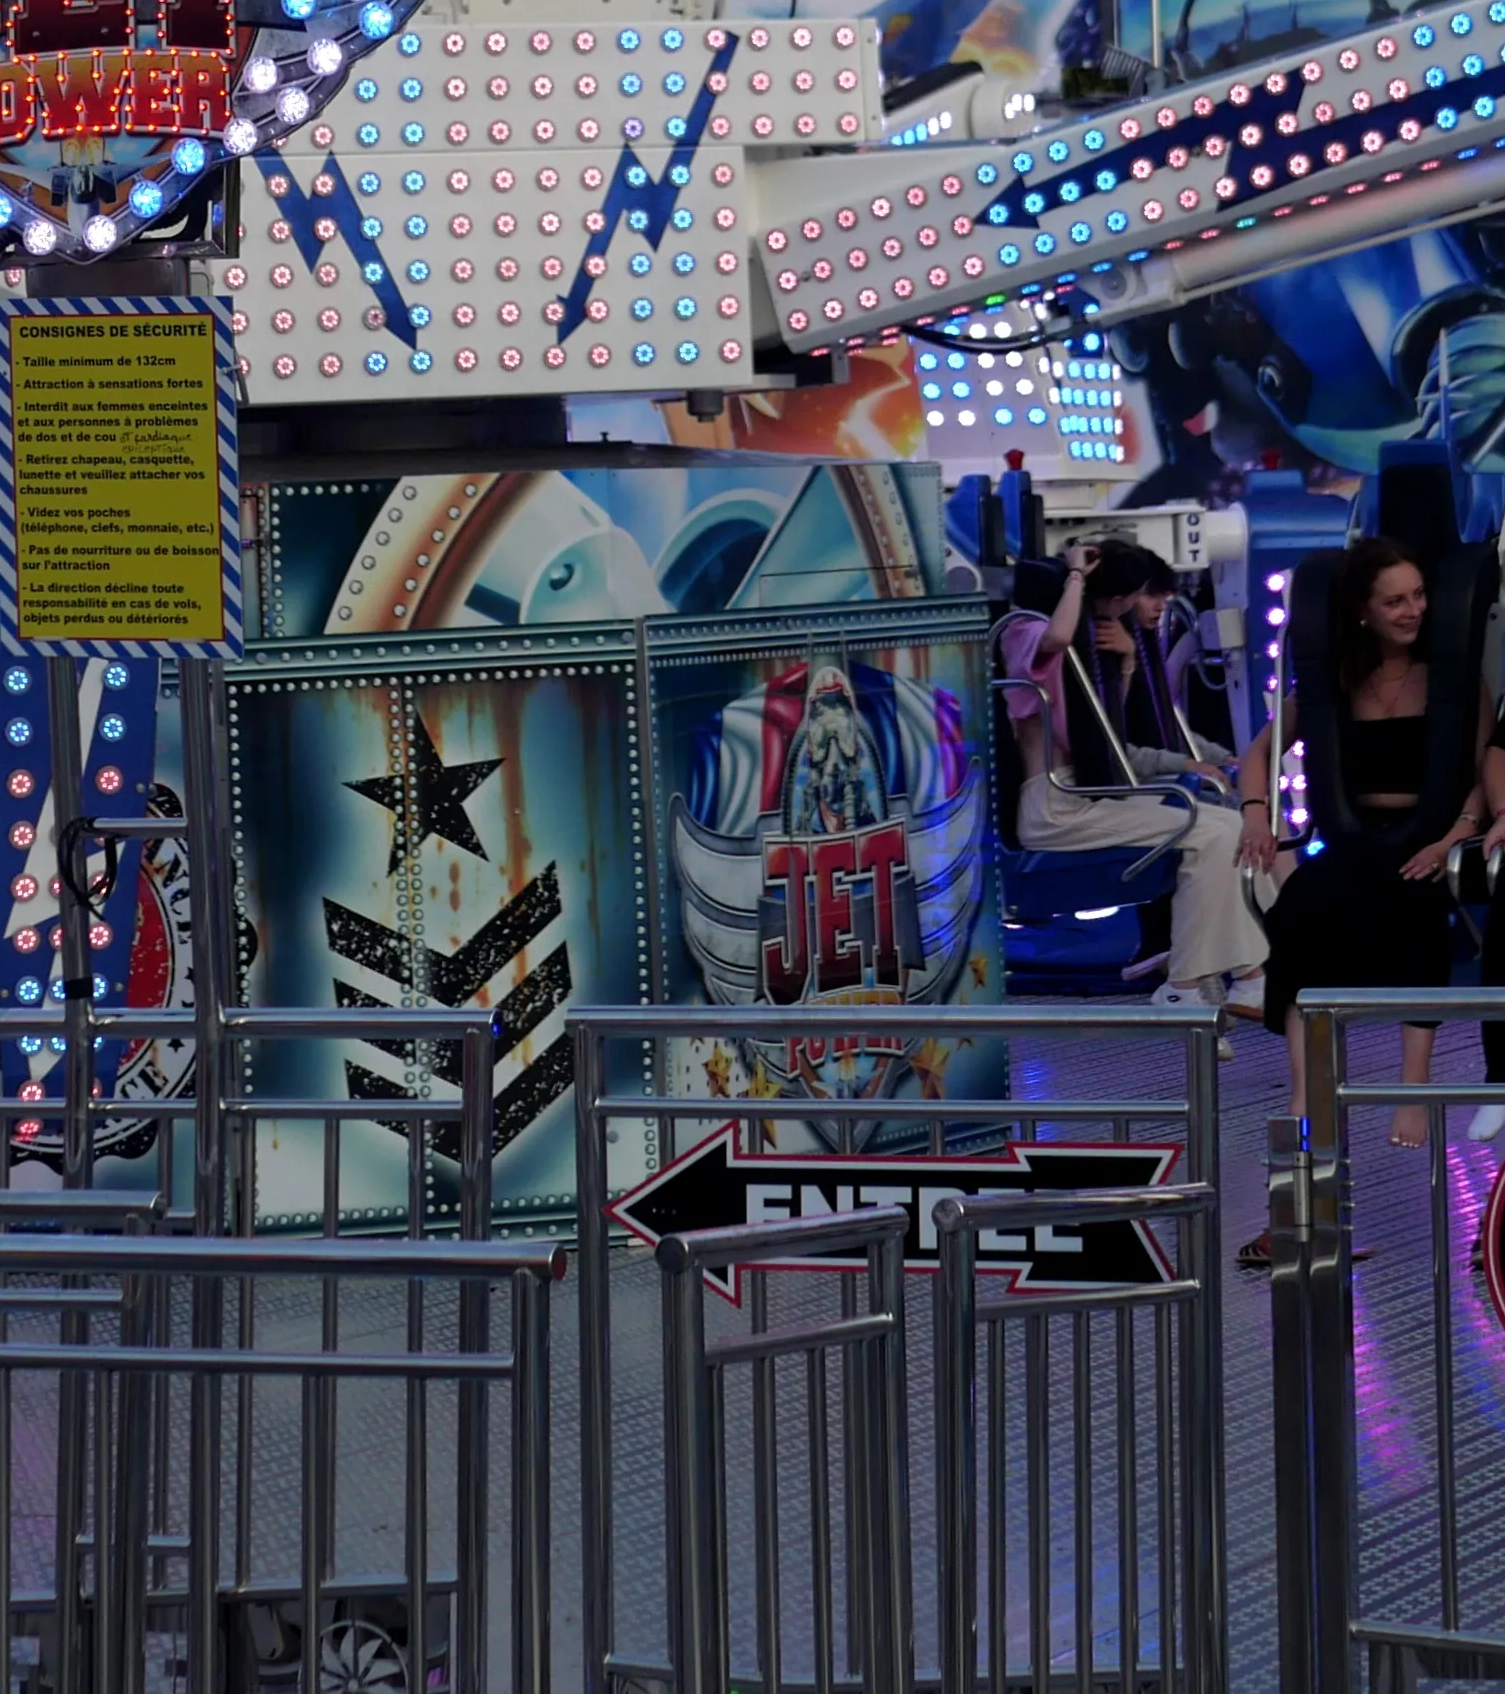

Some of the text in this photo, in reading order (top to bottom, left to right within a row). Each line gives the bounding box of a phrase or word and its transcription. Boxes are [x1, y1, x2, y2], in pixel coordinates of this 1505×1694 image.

[19, 322, 208, 338] CONSIGNES DE SÉCURITÉ
[23, 356, 176, 367] Taille minimum de 132cm
[23, 378, 203, 389] Attraction à sensations fortes
[24, 401, 208, 411] Interdit aux femmes enceintes
[17, 416, 198, 428] et aux personnes à problèmes
[18, 432, 116, 442] de dos et de cou
[25, 454, 194, 466] Retirez chapeau, casquette,
[19, 469, 205, 480] lunette et veuillez attacher vos
[19, 485, 88, 495] chaussures
[27, 507, 131, 520] Videz vos poches
[20, 522, 215, 535] (téléphone, clefs, monnaie, etc.)
[1186, 514, 1199, 564] OUT
[28, 544, 220, 555] Pas de nourriture ou de boisson
[22, 560, 42, 570] sur
[29, 583, 184, 593] La direction décline toute
[23, 598, 202, 611] responsabilité en cas de vols,
[23, 613, 189, 627] objets perdus ou détériorés
[762, 817, 910, 1006] JET
